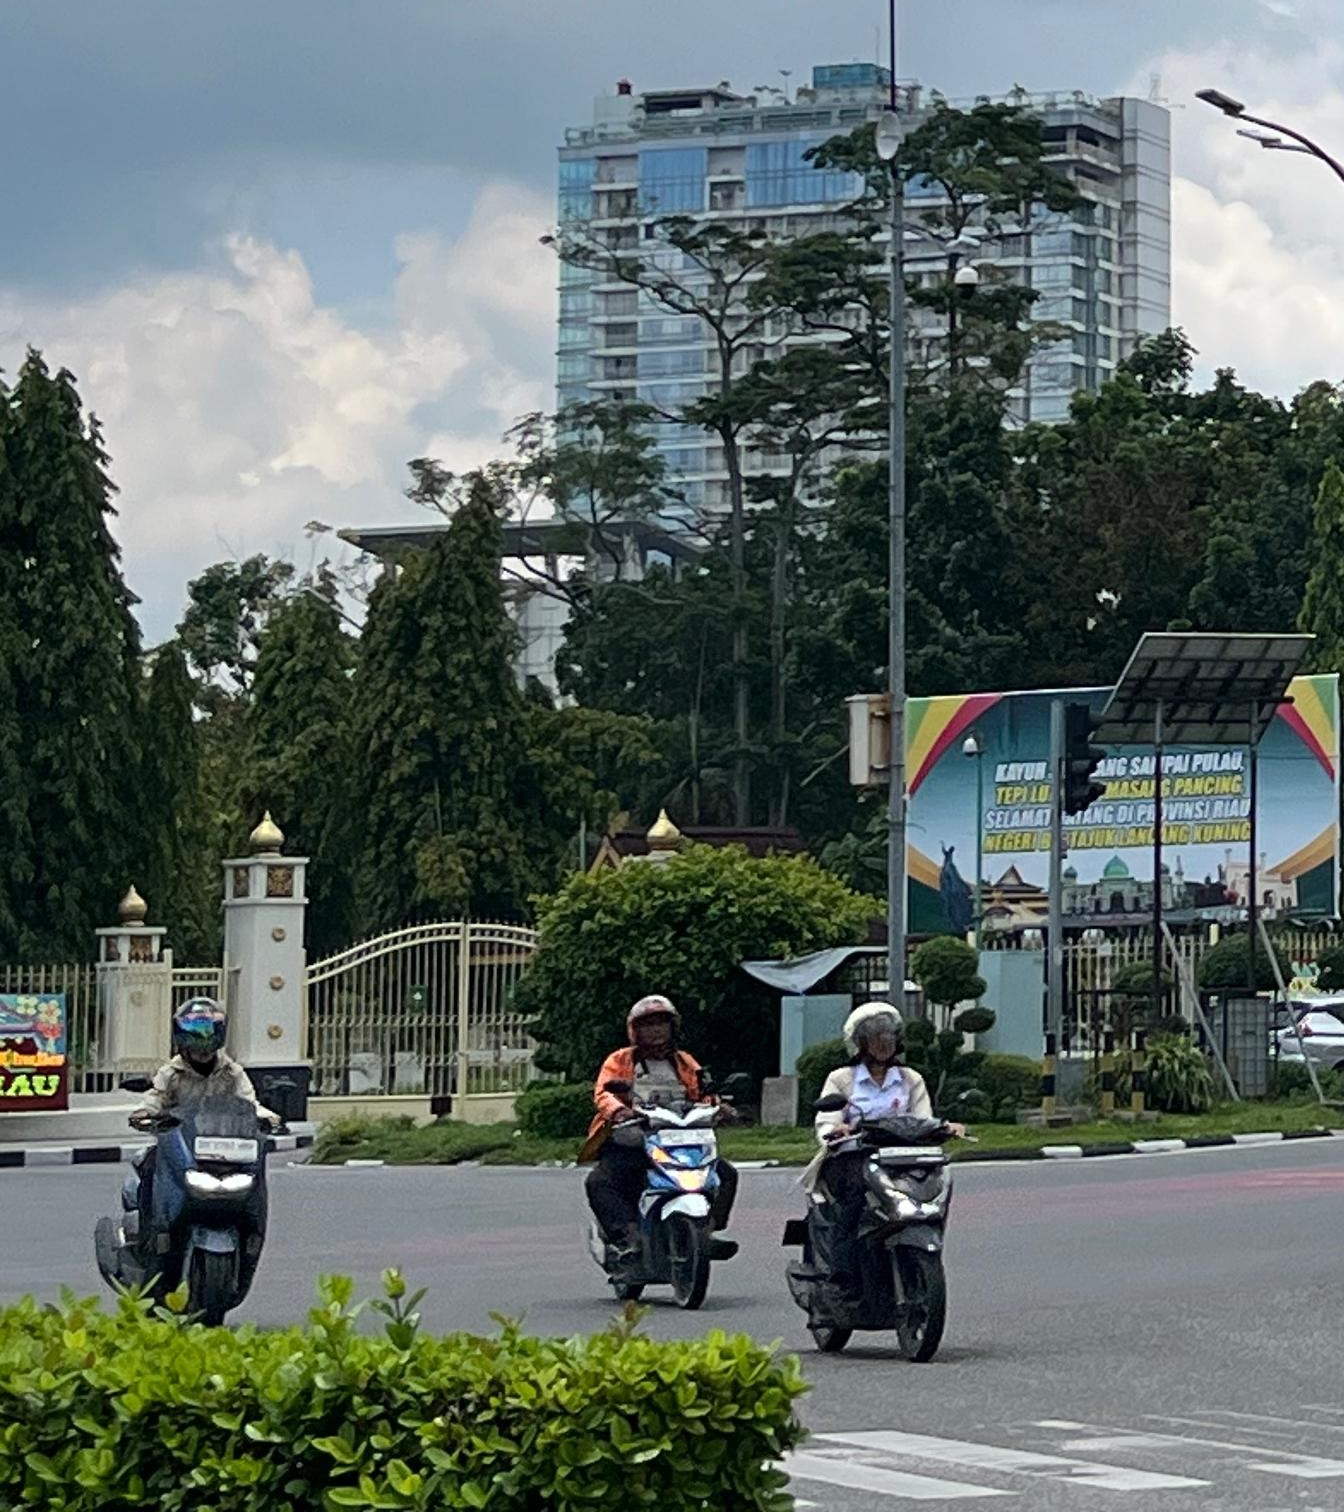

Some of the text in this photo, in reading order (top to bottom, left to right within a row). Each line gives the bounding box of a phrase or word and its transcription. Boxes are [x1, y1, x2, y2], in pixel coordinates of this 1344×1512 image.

[985, 809, 1052, 829] SELAMAT
[1136, 799, 1209, 822] PRVINSI
[1212, 798, 1250, 819] RIAU
